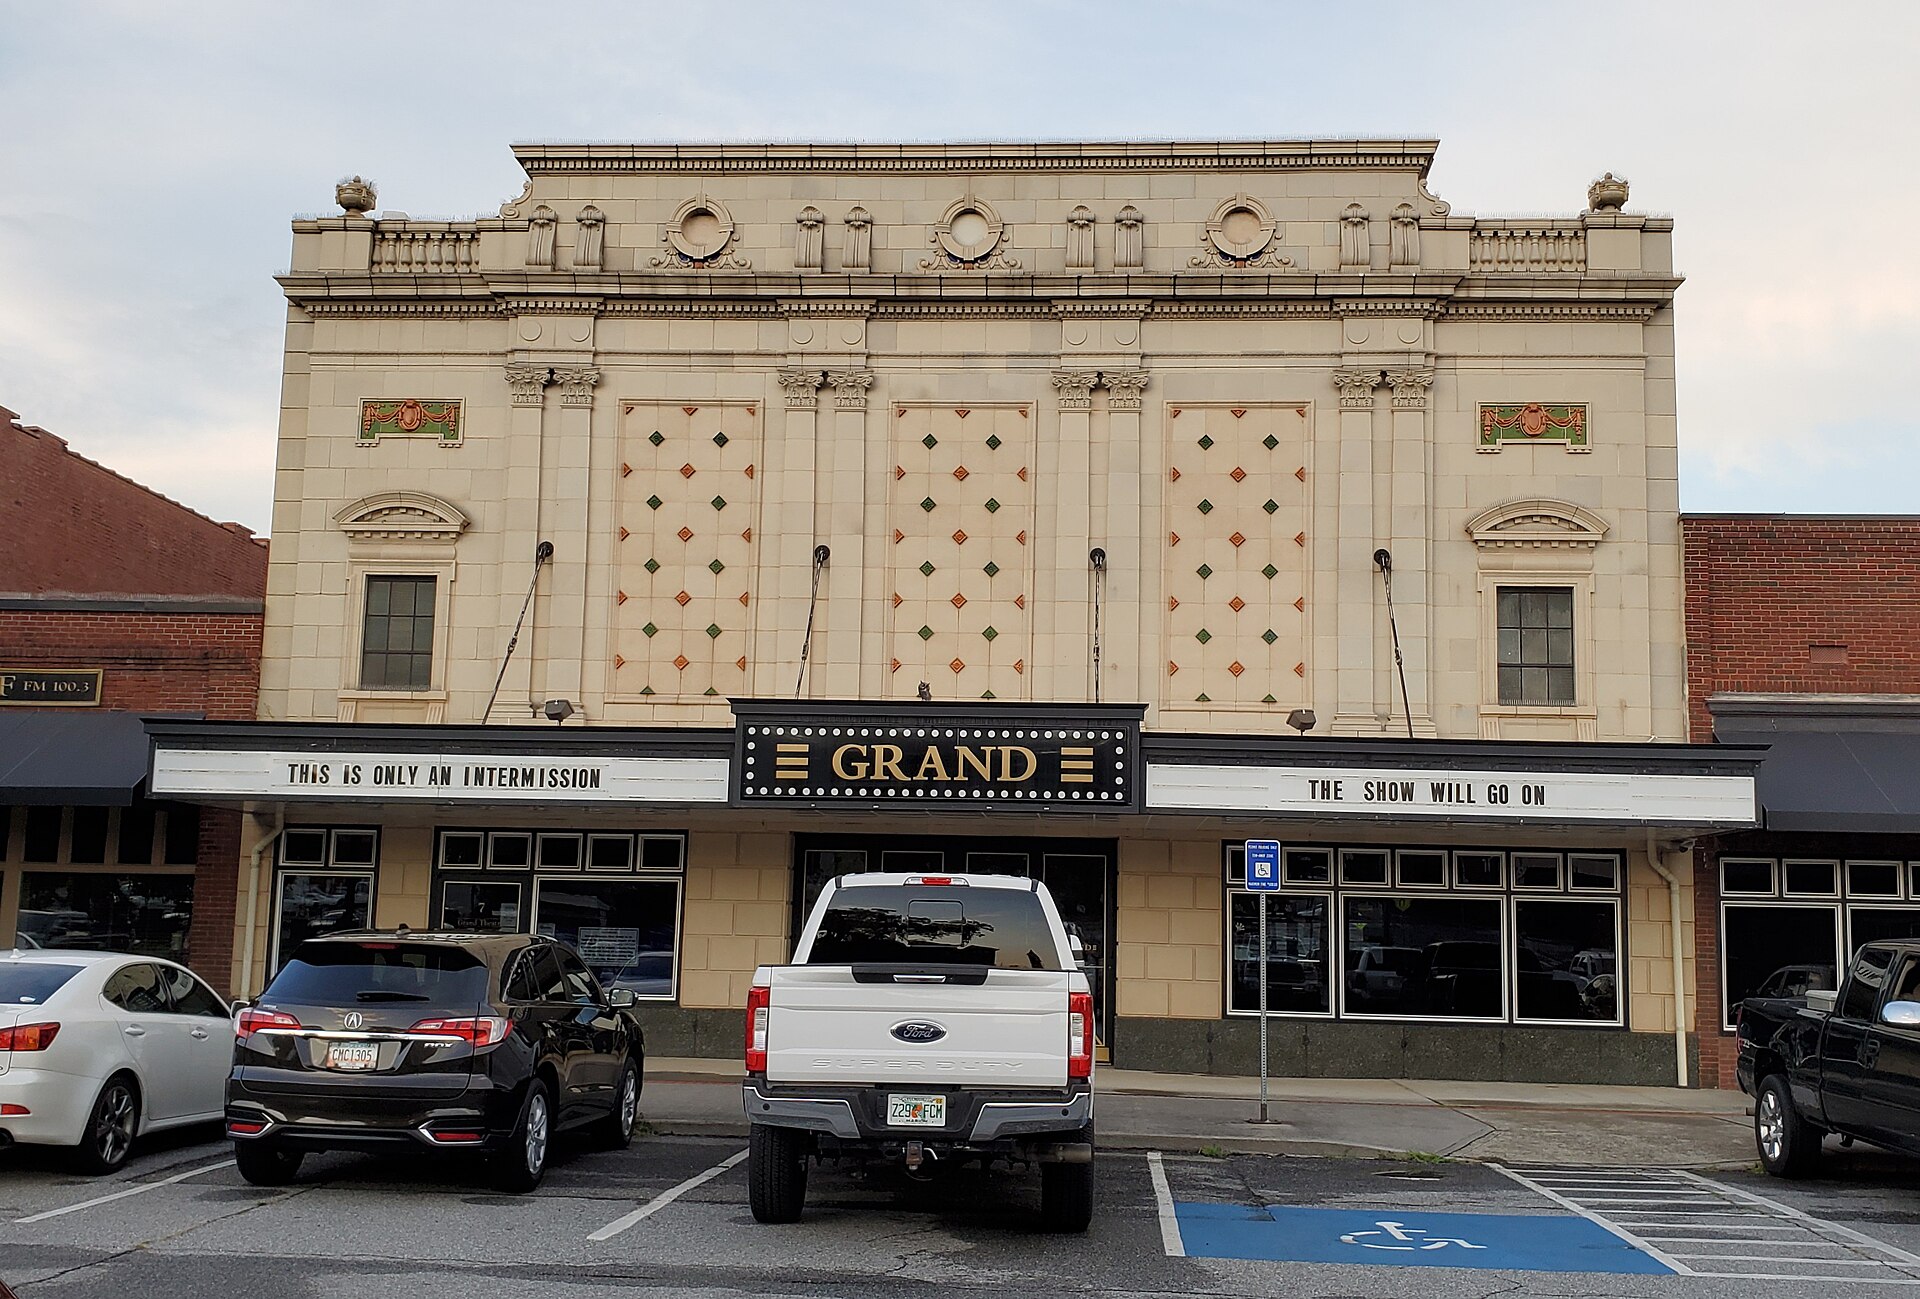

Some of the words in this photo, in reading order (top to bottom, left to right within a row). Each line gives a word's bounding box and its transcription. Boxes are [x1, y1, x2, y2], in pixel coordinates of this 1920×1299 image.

[23, 680, 47, 692] FM
[53, 681, 89, 692] 100.3
[831, 743, 1037, 783] GRAND
[288, 763, 330, 784] THIS
[343, 764, 362, 784] IS
[373, 765, 419, 785] ONLY
[428, 765, 451, 786] AN
[463, 766, 601, 789] INTERMISSION
[1308, 779, 1344, 801] THE
[1363, 781, 1415, 802] SHOW
[1430, 782, 1476, 804] WILL
[1487, 783, 1509, 805] GO
[1521, 784, 1546, 806] ON
[478, 902, 486, 913] 7
[903, 1024, 934, 1038] Ford
[812, 1058, 926, 1070] SUPER
[936, 1060, 1024, 1072] DUTY
[892, 1103, 911, 1118] Z29
